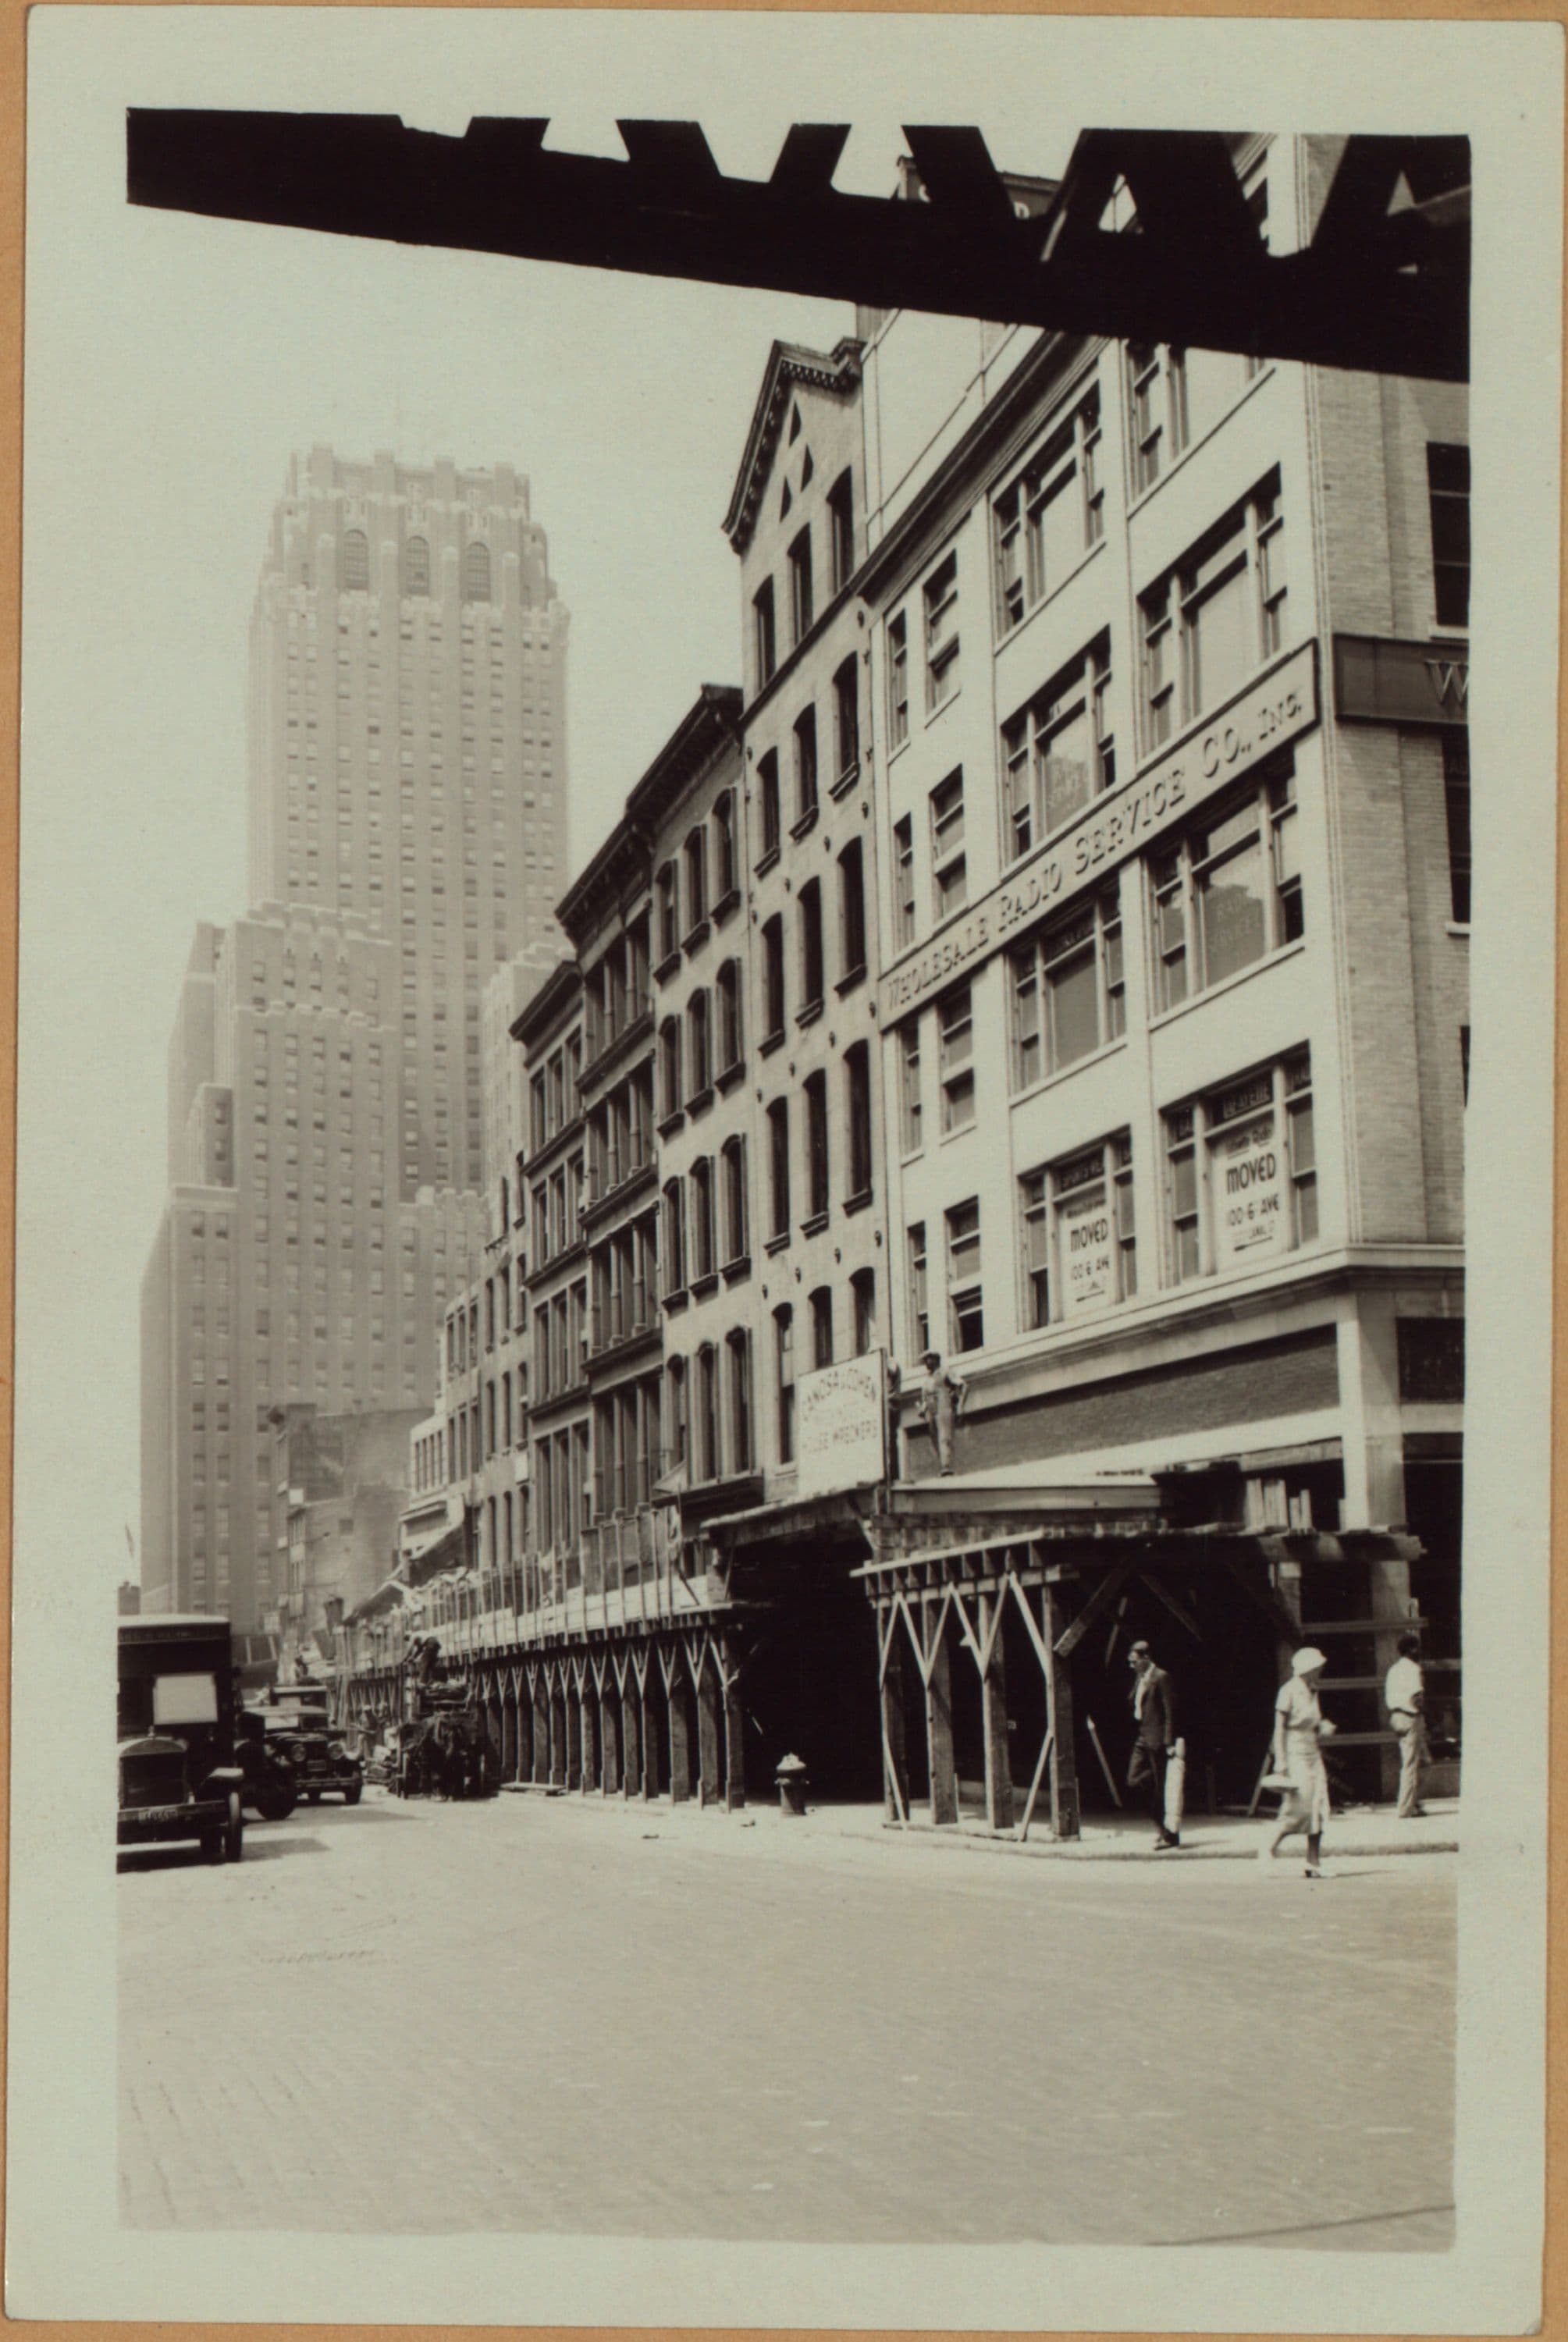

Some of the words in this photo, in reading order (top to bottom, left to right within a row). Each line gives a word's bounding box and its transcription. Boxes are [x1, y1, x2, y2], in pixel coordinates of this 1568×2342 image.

[887, 917, 990, 1011] WHOLESALE
[997, 862, 1062, 933] RADIO
[1074, 768, 1186, 876] SERVICE
[1226, 1152, 1276, 1195] MOVED
[1260, 1193, 1280, 1214] AVE
[1070, 1217, 1108, 1253] MOVED
